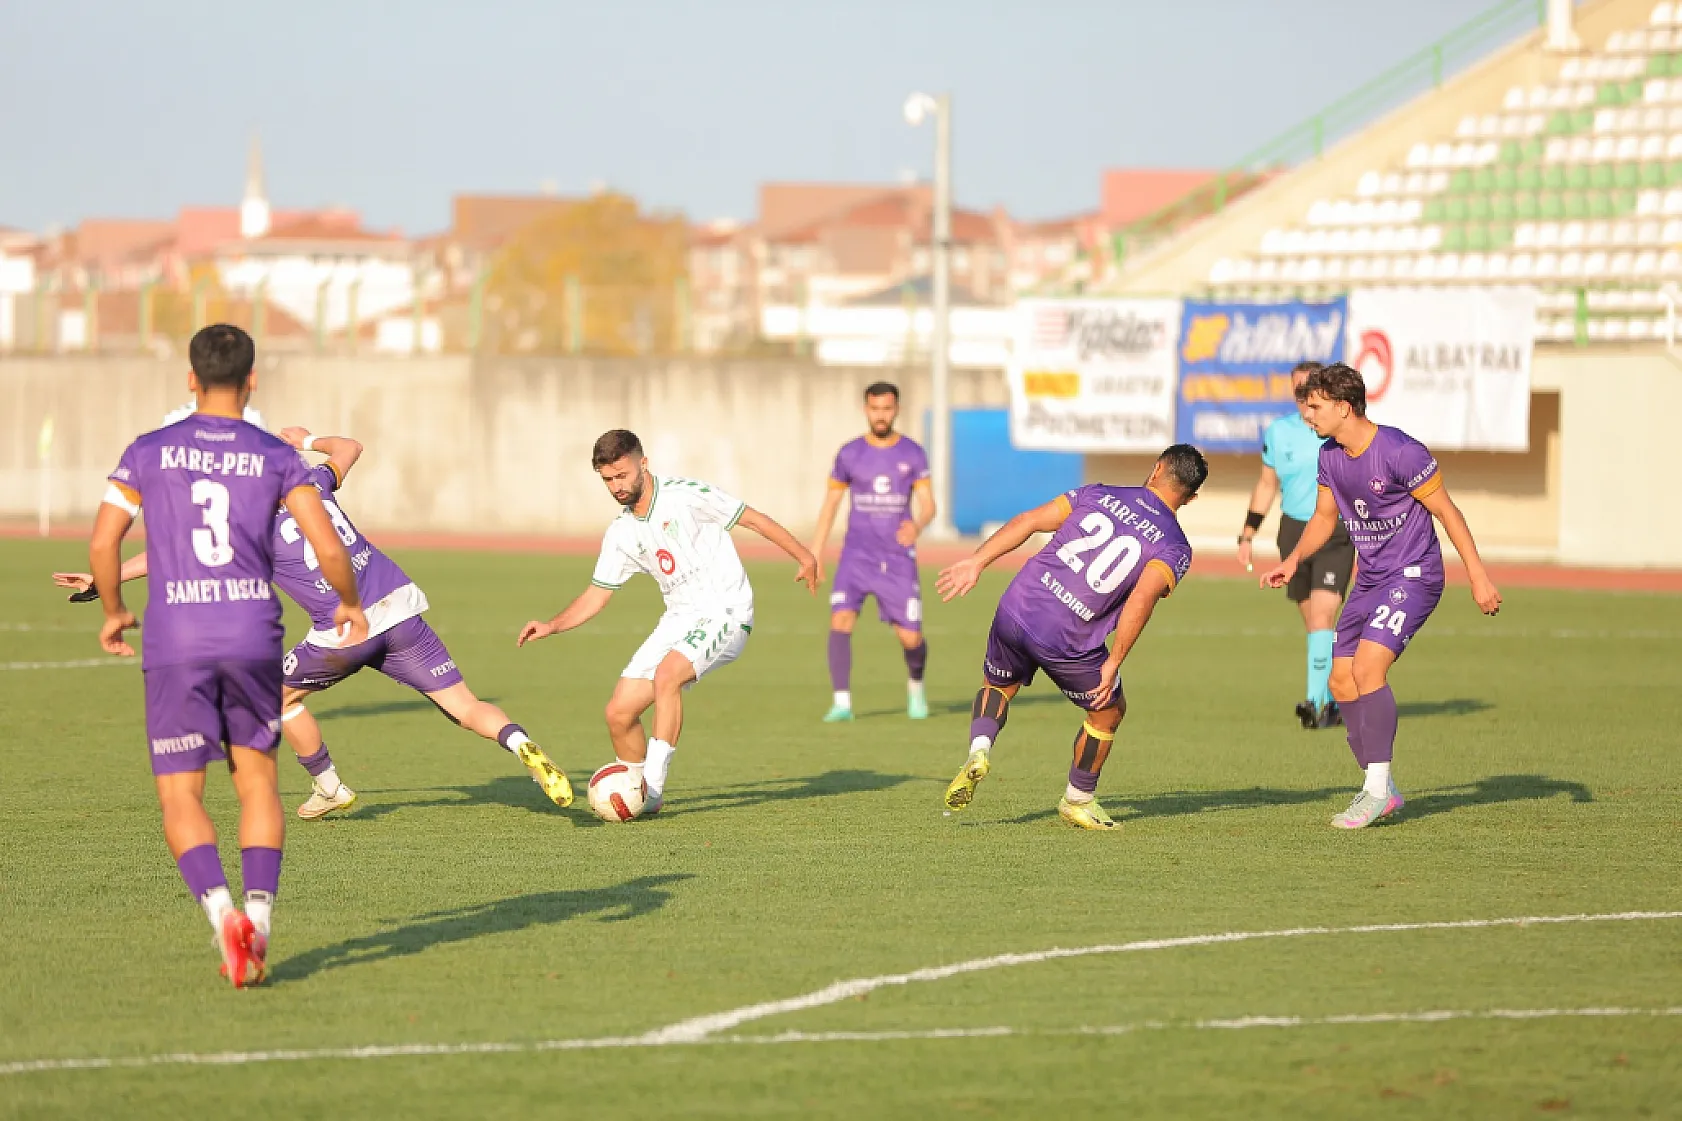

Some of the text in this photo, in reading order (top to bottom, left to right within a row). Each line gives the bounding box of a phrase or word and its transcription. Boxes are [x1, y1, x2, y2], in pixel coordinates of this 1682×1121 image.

[160, 445, 265, 477] KARE-PEN
[191, 478, 235, 567] 3
[1097, 494, 1165, 545] KARE-PEN
[1055, 512, 1142, 594] 20
[166, 579, 221, 604] SAMET
[1369, 604, 1407, 636] 24
